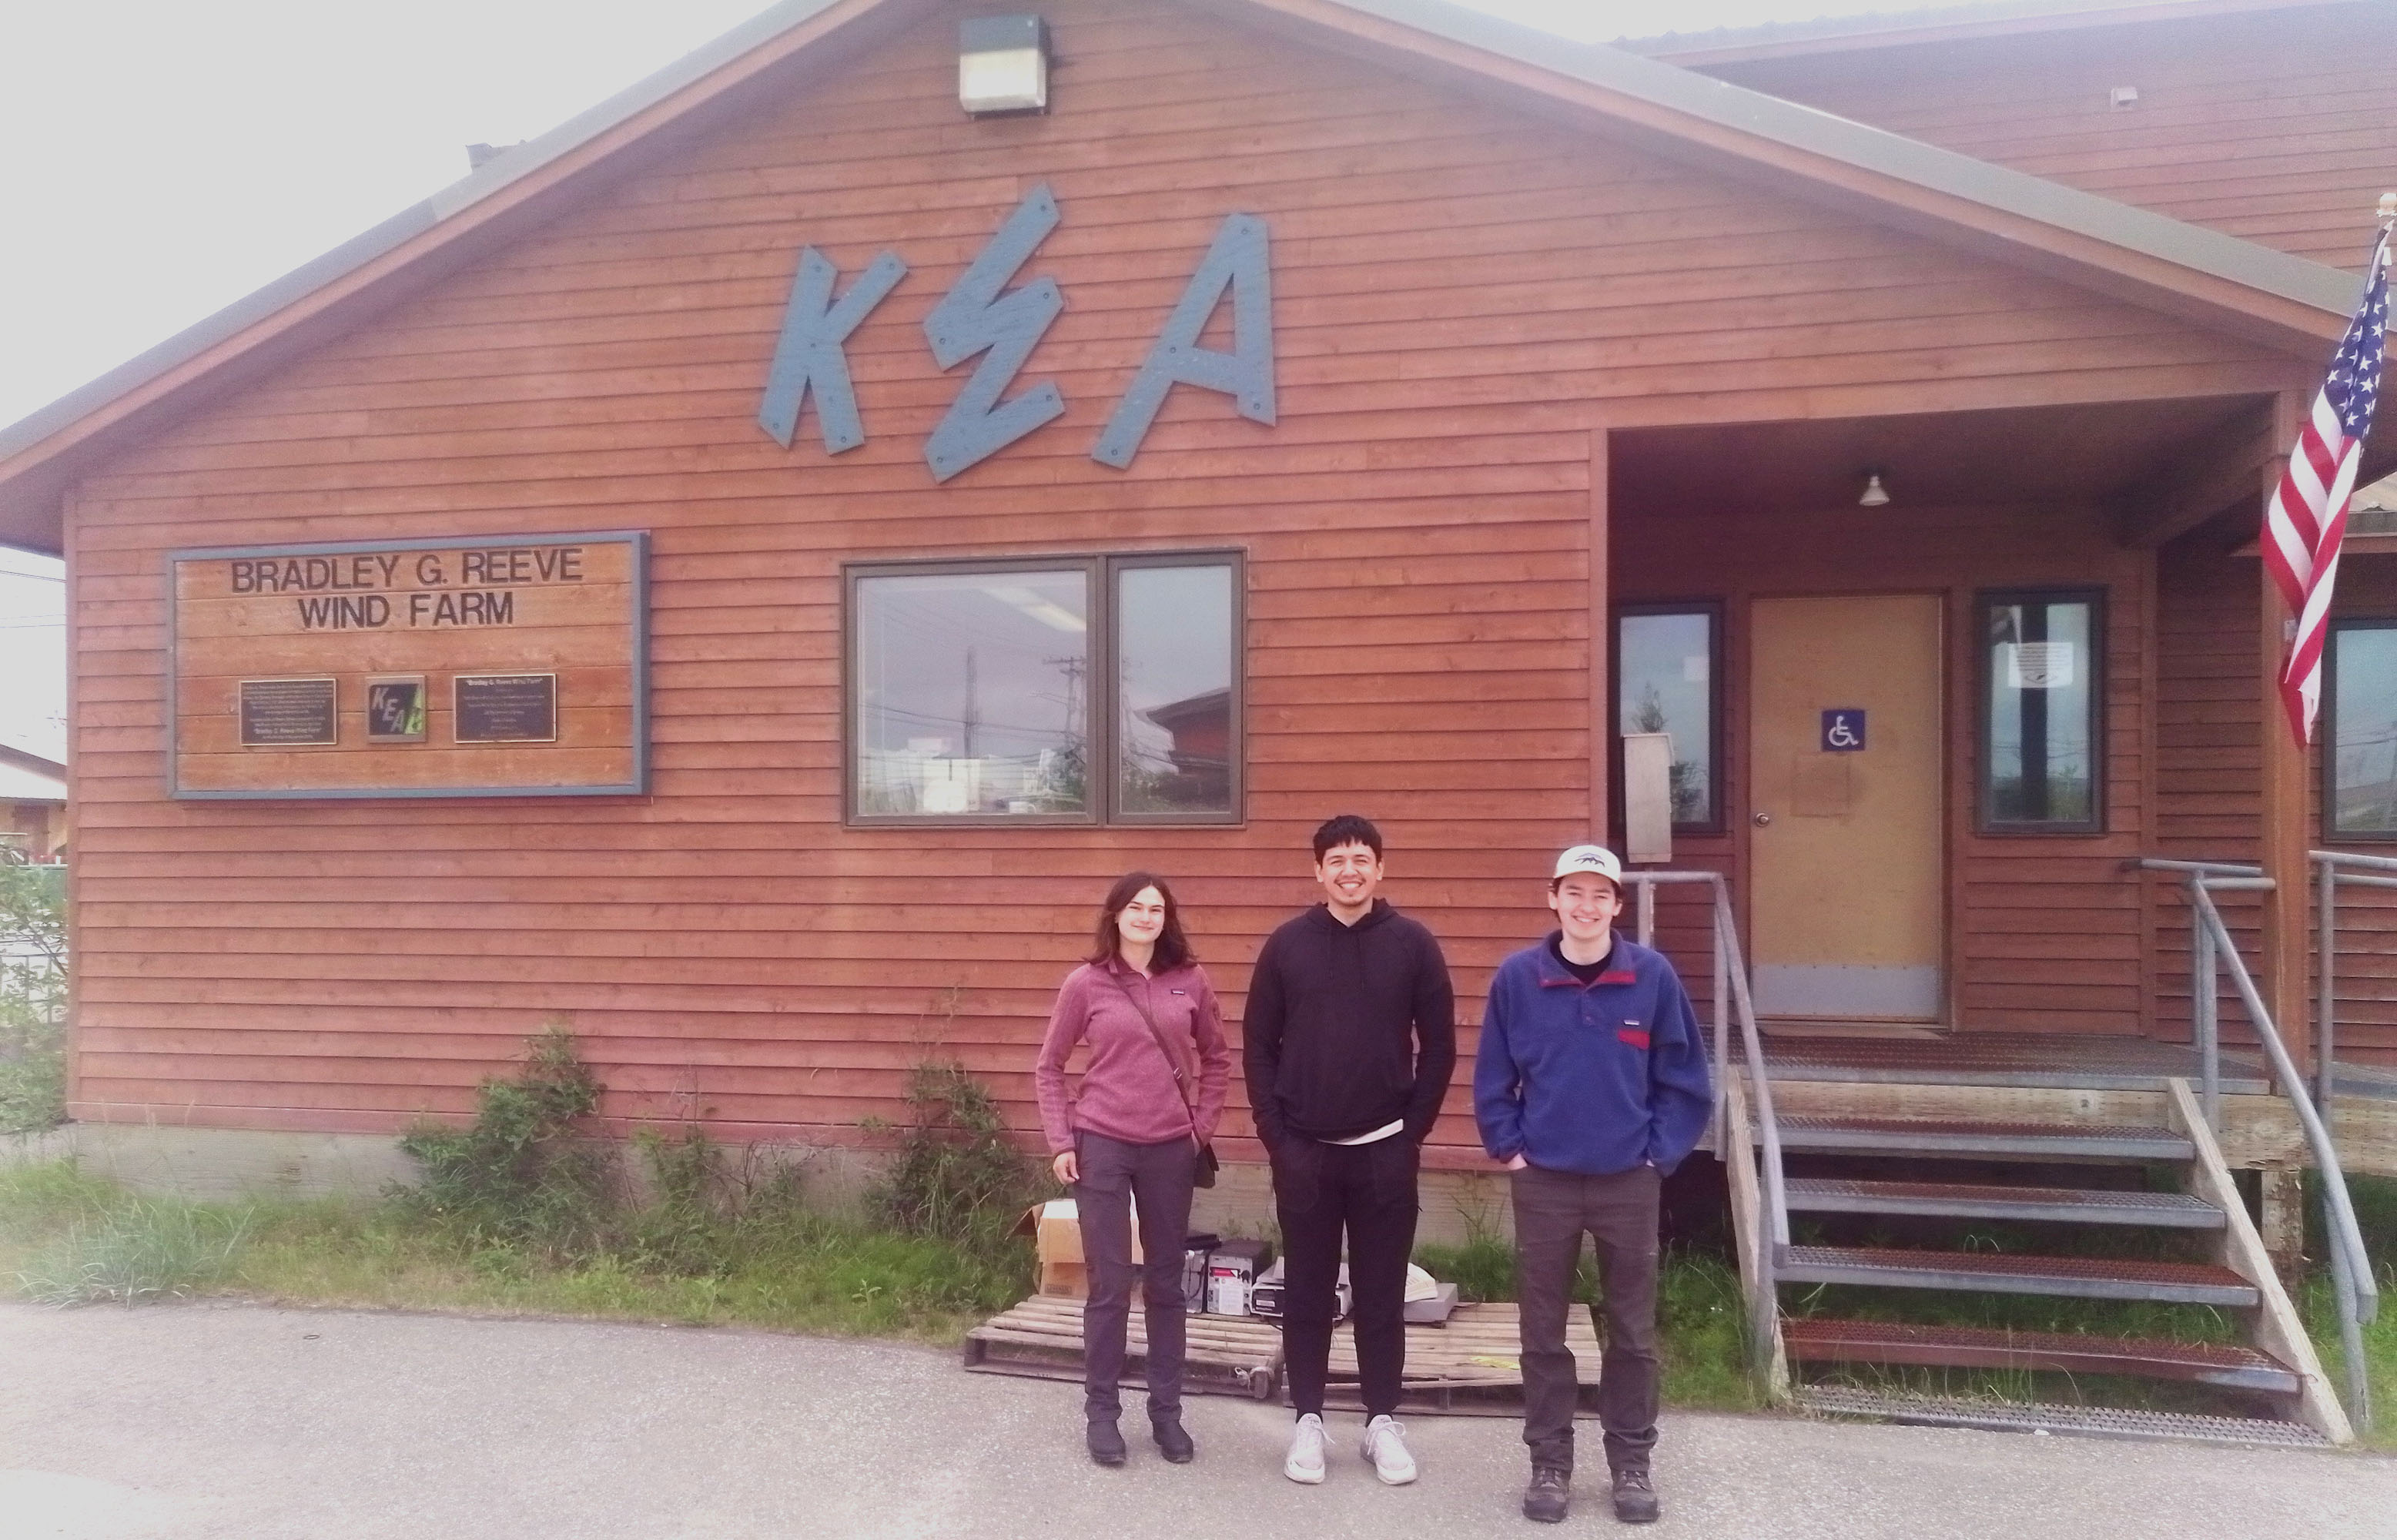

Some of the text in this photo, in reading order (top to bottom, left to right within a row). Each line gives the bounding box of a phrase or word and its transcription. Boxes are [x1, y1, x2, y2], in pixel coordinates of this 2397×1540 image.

[232, 547, 584, 594] BRADLEY G. REEVE
[298, 591, 513, 630] WIND FARM
